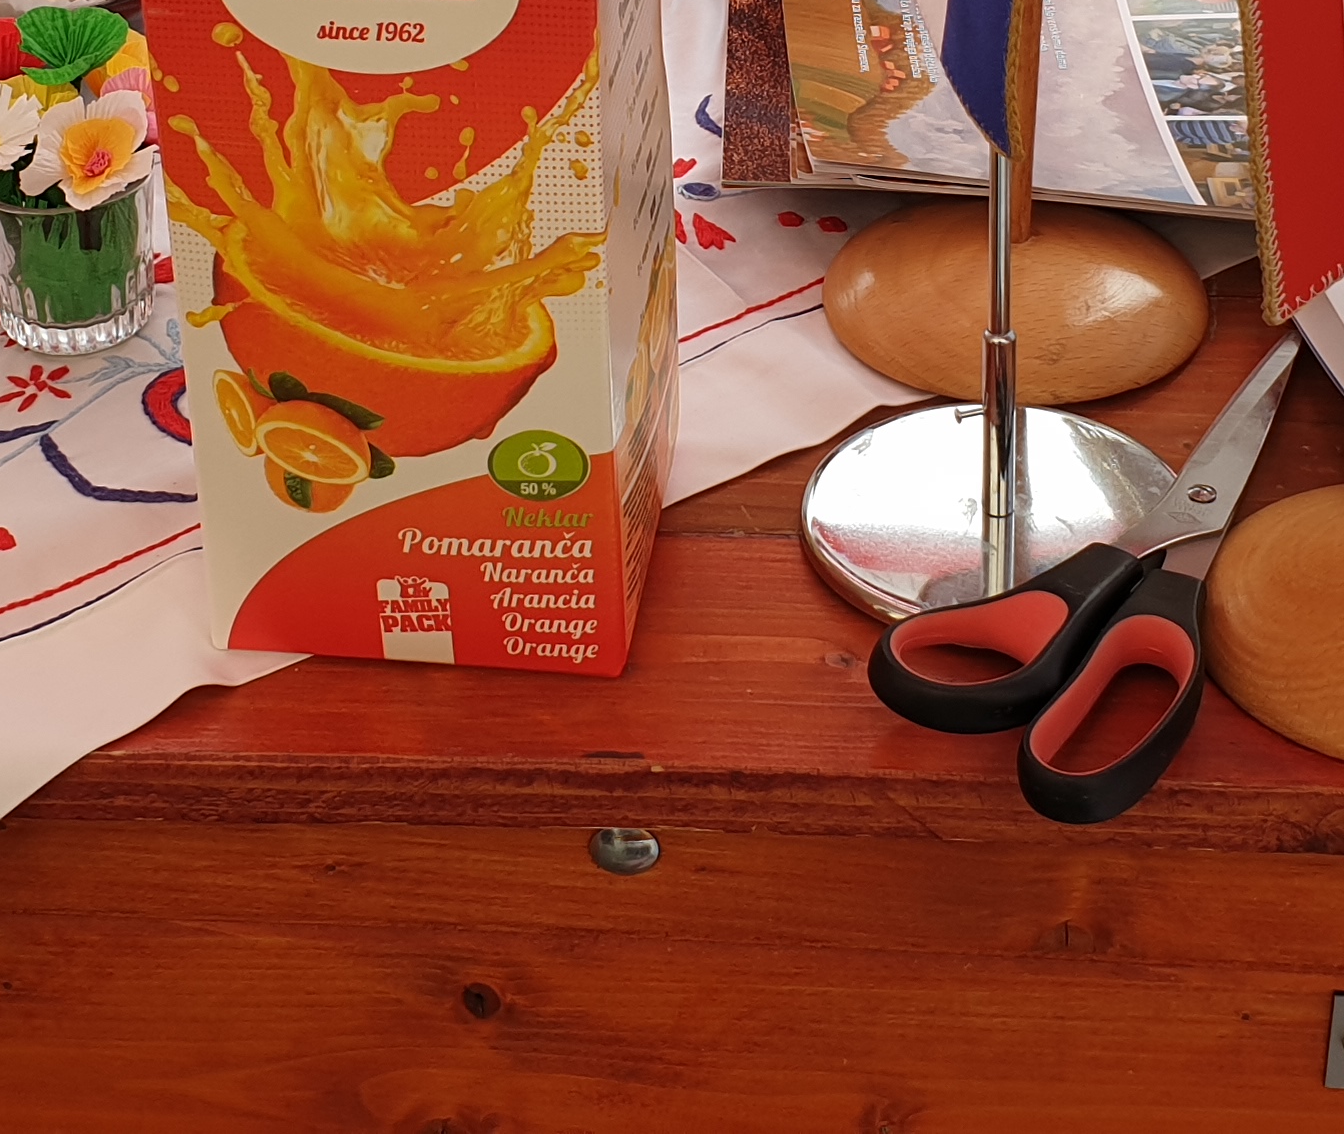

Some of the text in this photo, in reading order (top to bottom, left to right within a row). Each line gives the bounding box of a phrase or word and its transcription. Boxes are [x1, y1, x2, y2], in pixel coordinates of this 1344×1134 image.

[317, 21, 425, 43] since 1962
[520, 482, 557, 495] 50 %
[502, 506, 594, 528] Nektar
[397, 526, 593, 559] Pomaranča
[480, 561, 595, 585] Naranča
[378, 598, 451, 614] FAMILY
[490, 586, 597, 610] Arancia
[380, 613, 452, 633] PACK
[502, 612, 598, 638] Orange
[503, 636, 599, 663] Orange
